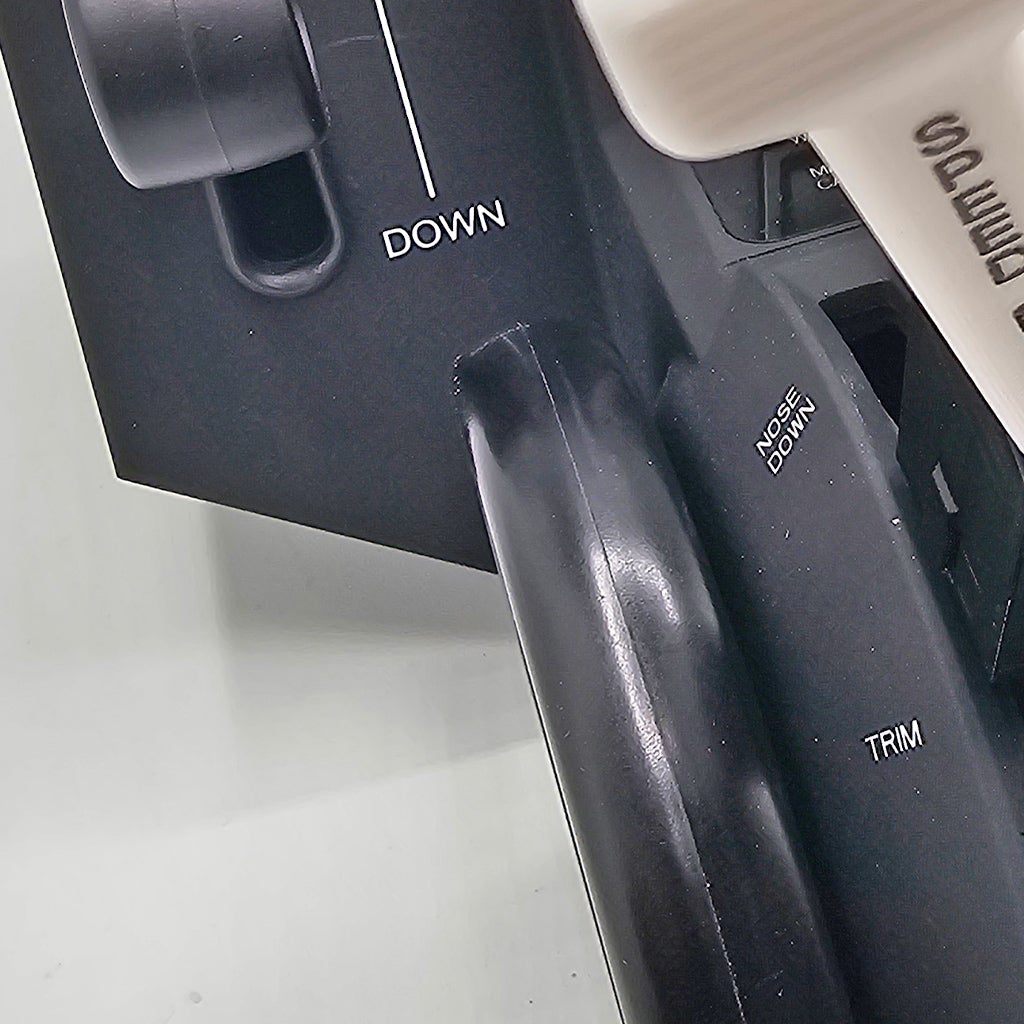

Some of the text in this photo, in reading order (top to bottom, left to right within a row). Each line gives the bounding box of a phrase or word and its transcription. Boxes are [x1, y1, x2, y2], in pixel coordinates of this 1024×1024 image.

[381, 199, 507, 260] DOWN
[755, 385, 802, 457] NOSE
[766, 396, 817, 475] DOWN
[863, 719, 924, 762] TRIM
